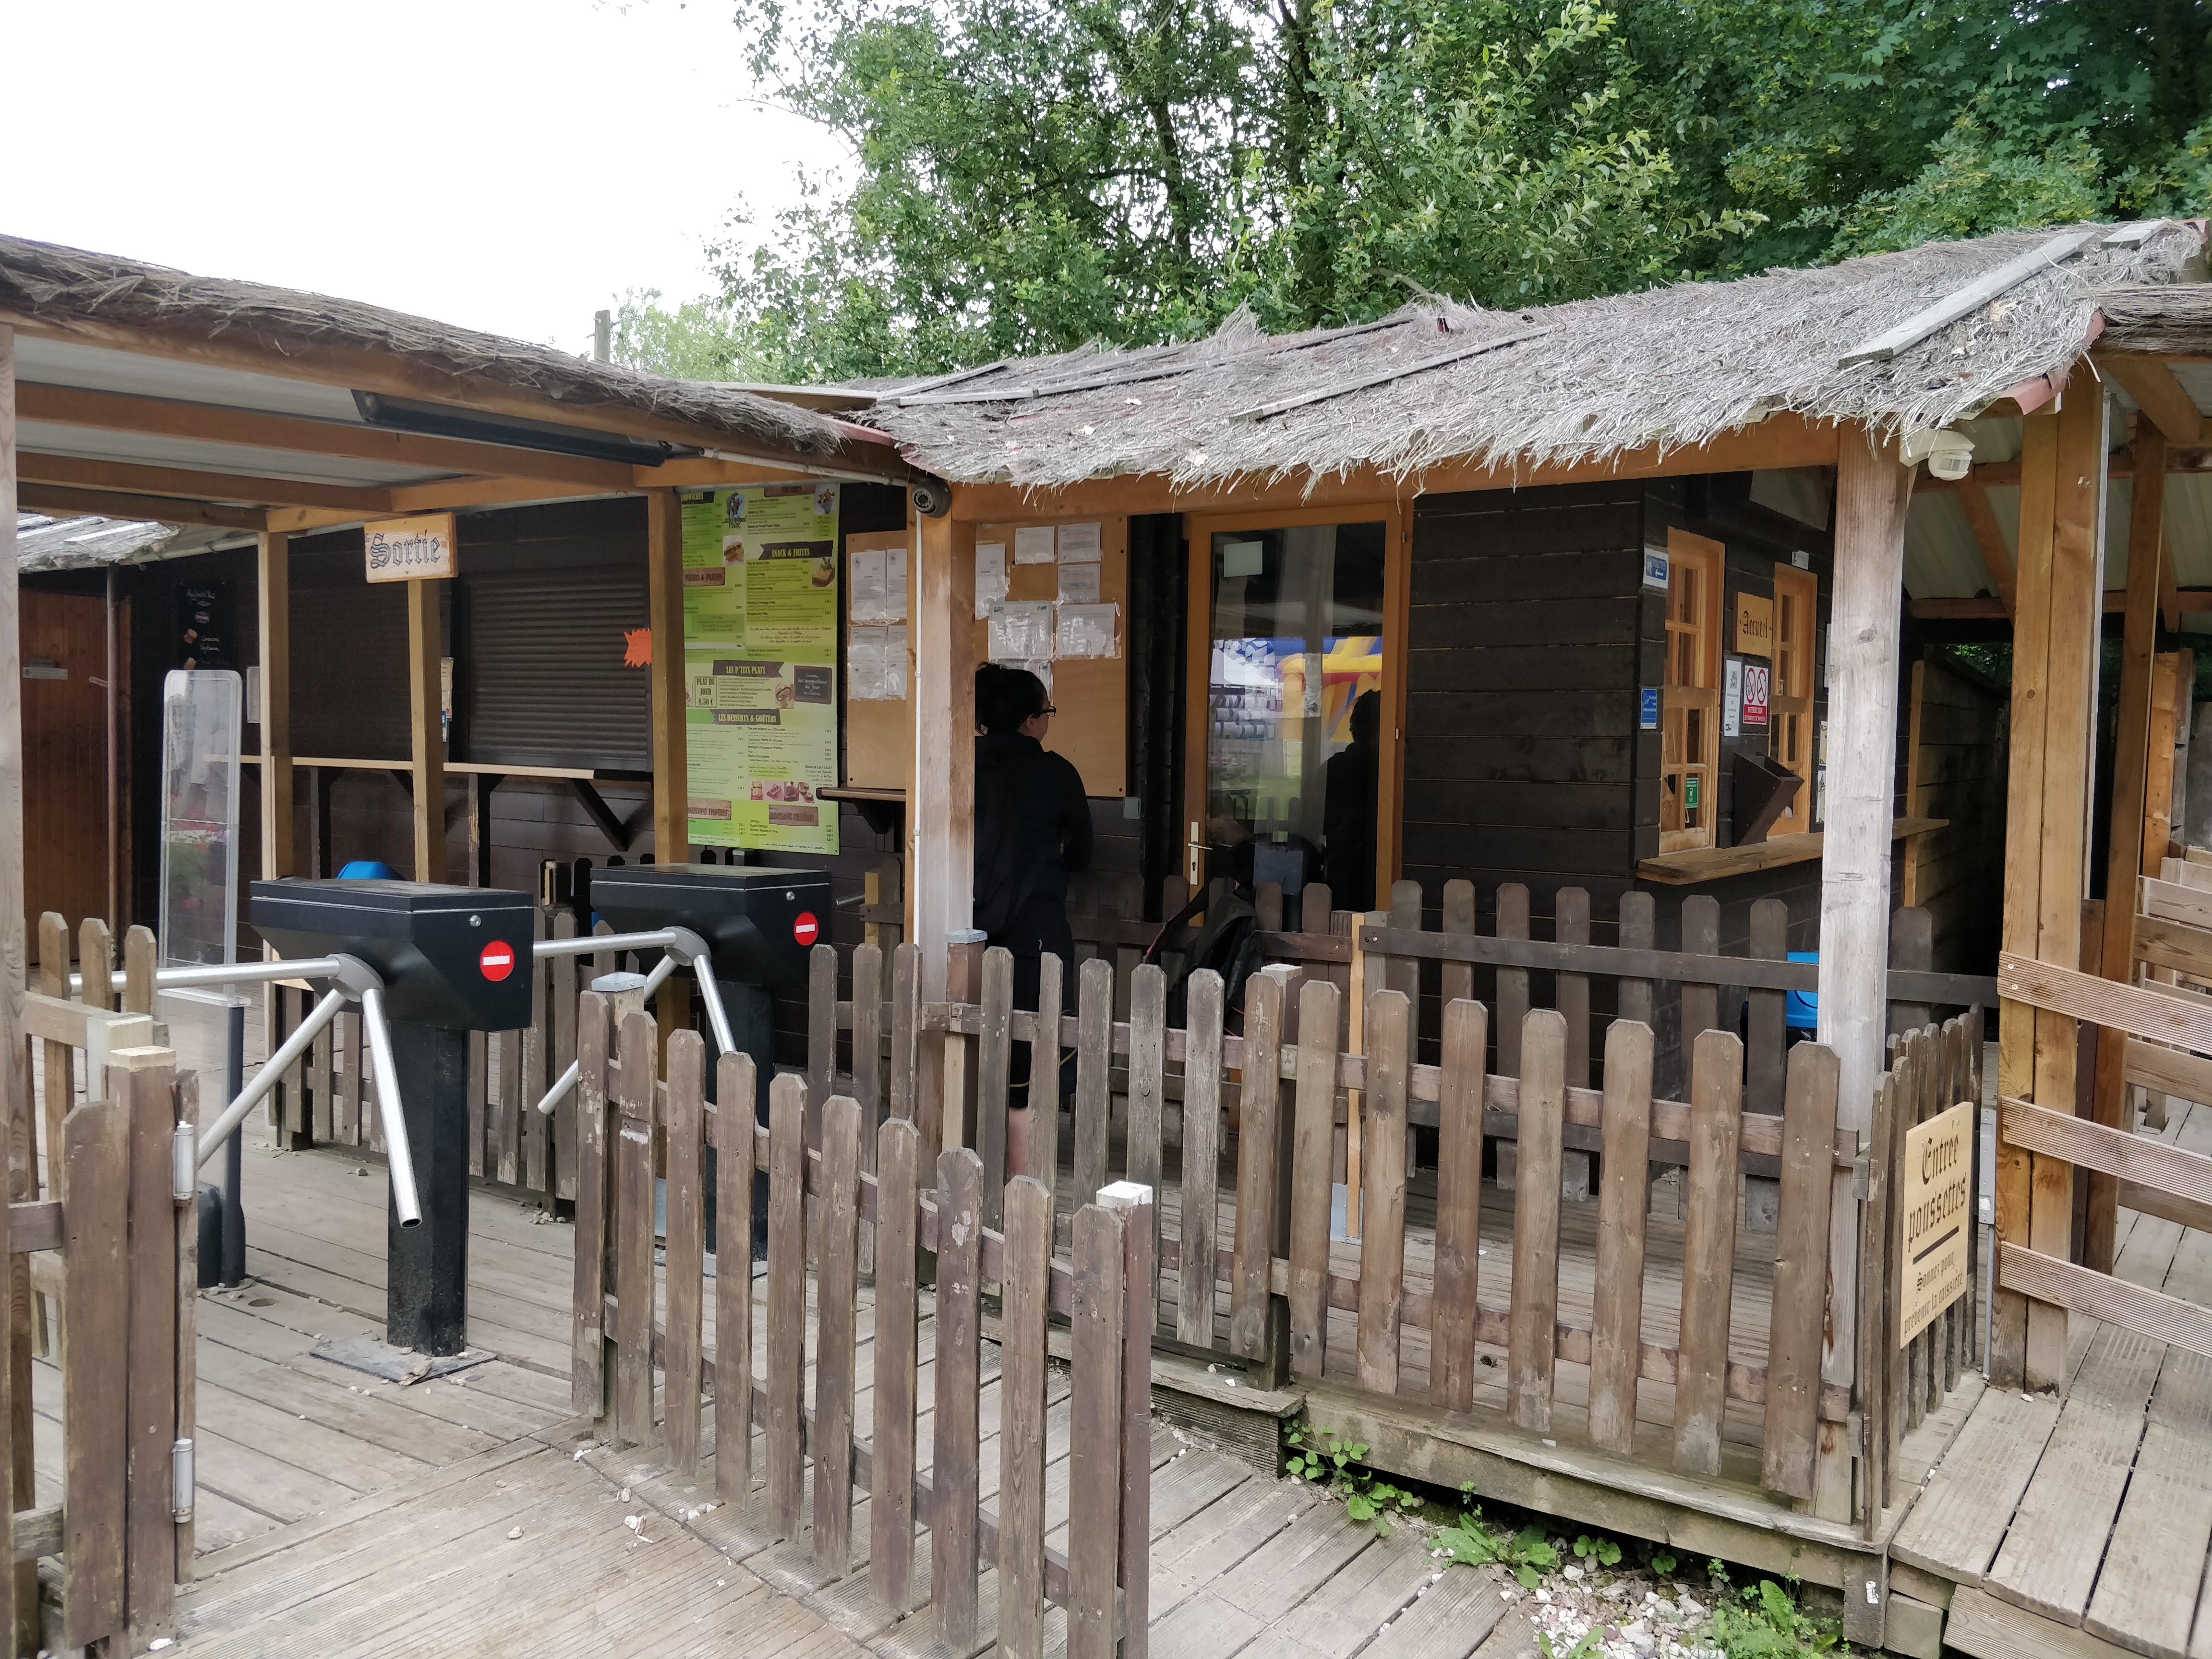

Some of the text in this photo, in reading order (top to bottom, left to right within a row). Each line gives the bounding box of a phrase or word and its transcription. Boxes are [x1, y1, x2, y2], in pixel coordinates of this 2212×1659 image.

[371, 529, 441, 569] Sortie
[771, 549, 786, 557] SNACK
[793, 548, 810, 556] FRITES
[1743, 610, 1767, 639] Accueil
[727, 714, 749, 722] DESSERTS
[755, 714, 777, 723] GOÛTERS
[769, 812, 793, 820] BOISSONS
[1922, 1120, 1959, 1185] Entrée
[1908, 1172, 1967, 1253] poussettes
[1916, 1263, 1939, 1295] Sonnez
[1932, 1293, 1937, 1311] la
